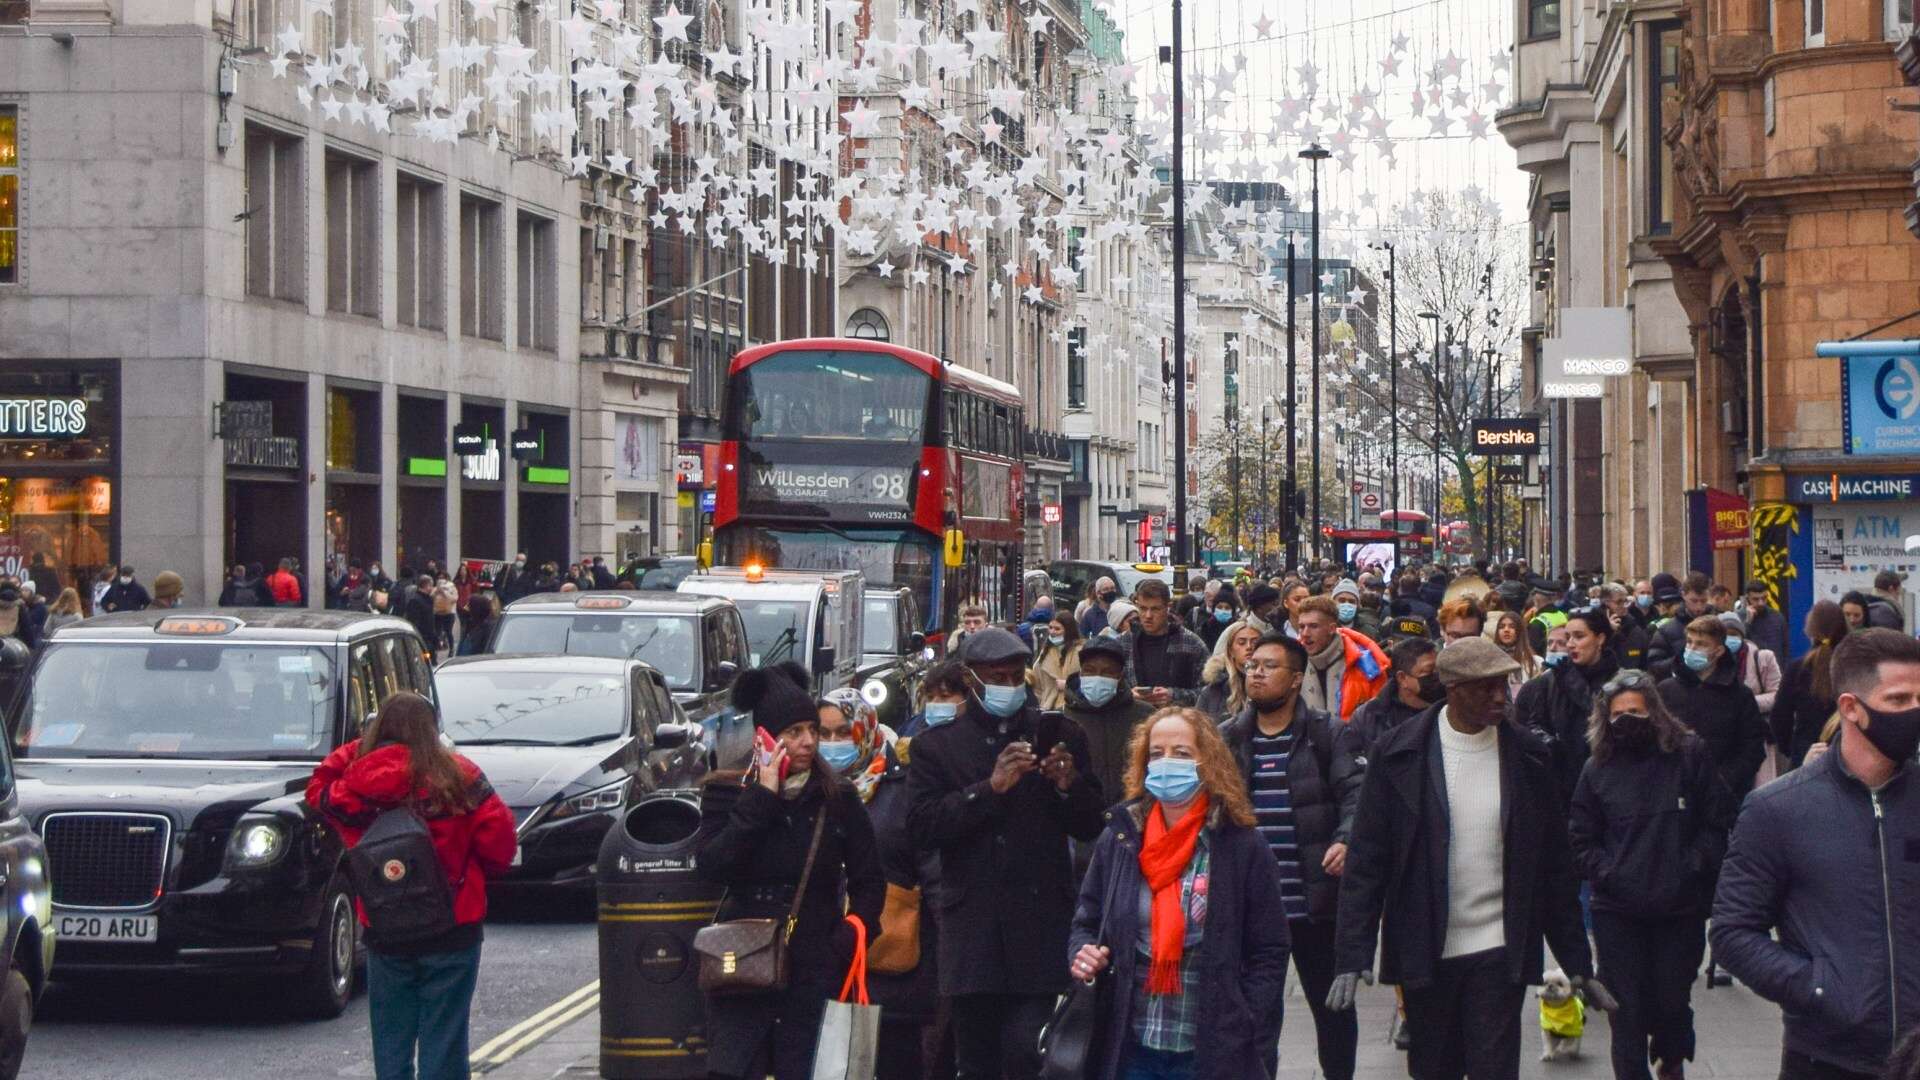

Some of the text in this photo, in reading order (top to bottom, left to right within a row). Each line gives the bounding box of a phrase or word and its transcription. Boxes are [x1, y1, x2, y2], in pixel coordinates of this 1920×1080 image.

[1563, 359, 1628, 374] MANGO
[1544, 383, 1600, 397] MANGO
[0, 400, 86, 433] TTERS
[1477, 430, 1535, 444] Bershka
[1875, 426, 1920, 437] CURRENC
[757, 469, 904, 499] Willesden 98
[1802, 480, 1911, 495] CASH MACHINE
[1716, 511, 1734, 521] BIG
[1853, 514, 1900, 538] ATM
[634, 859, 682, 869] general litter
[55, 918, 148, 937] C20 ARU
